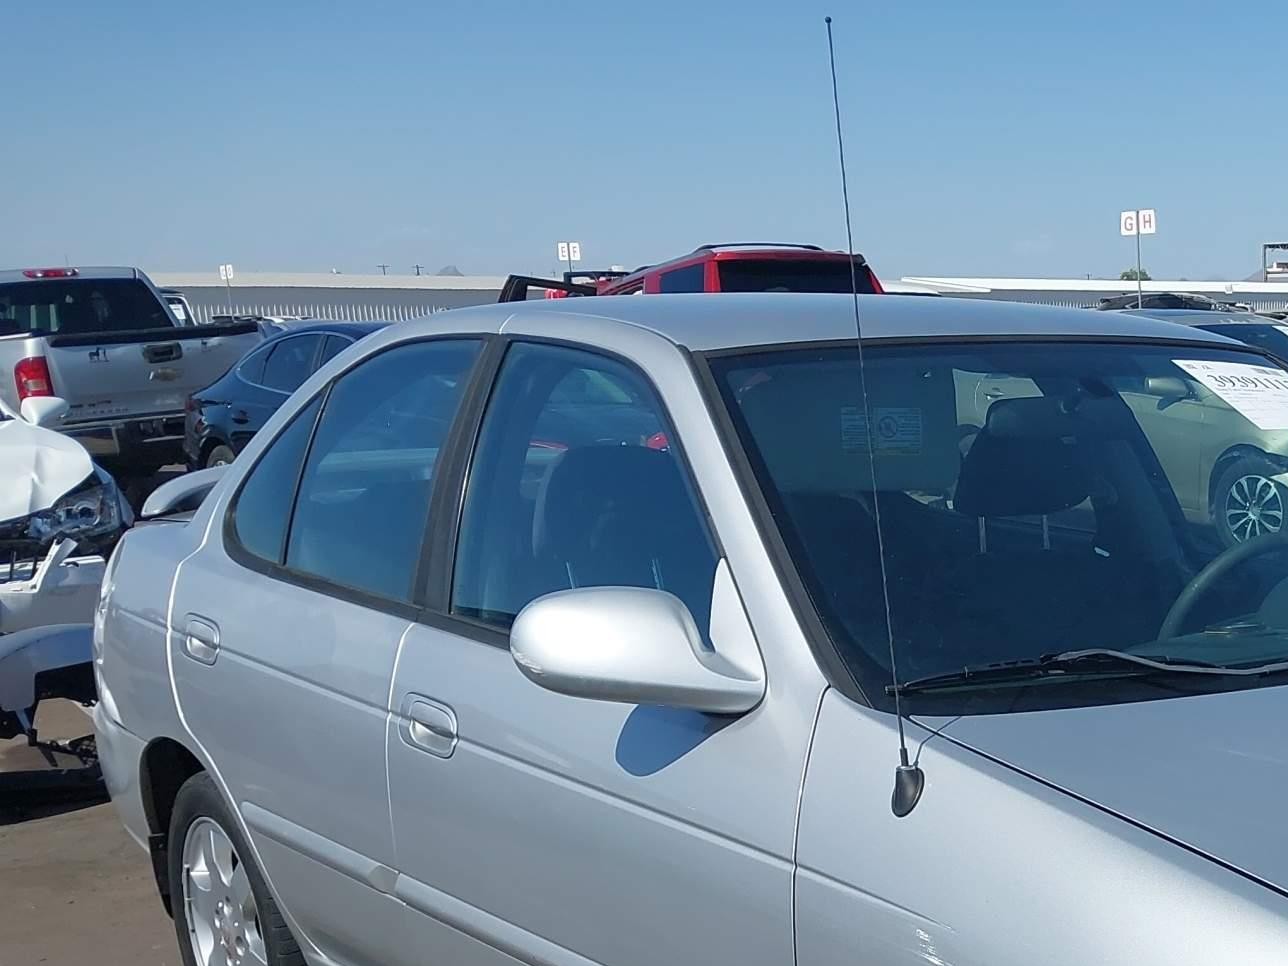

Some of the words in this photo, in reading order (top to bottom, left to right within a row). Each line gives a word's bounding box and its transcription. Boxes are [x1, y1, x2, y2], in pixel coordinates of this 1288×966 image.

[1124, 215, 1134, 232] G
[1143, 213, 1152, 229] H
[561, 246, 567, 258] E
